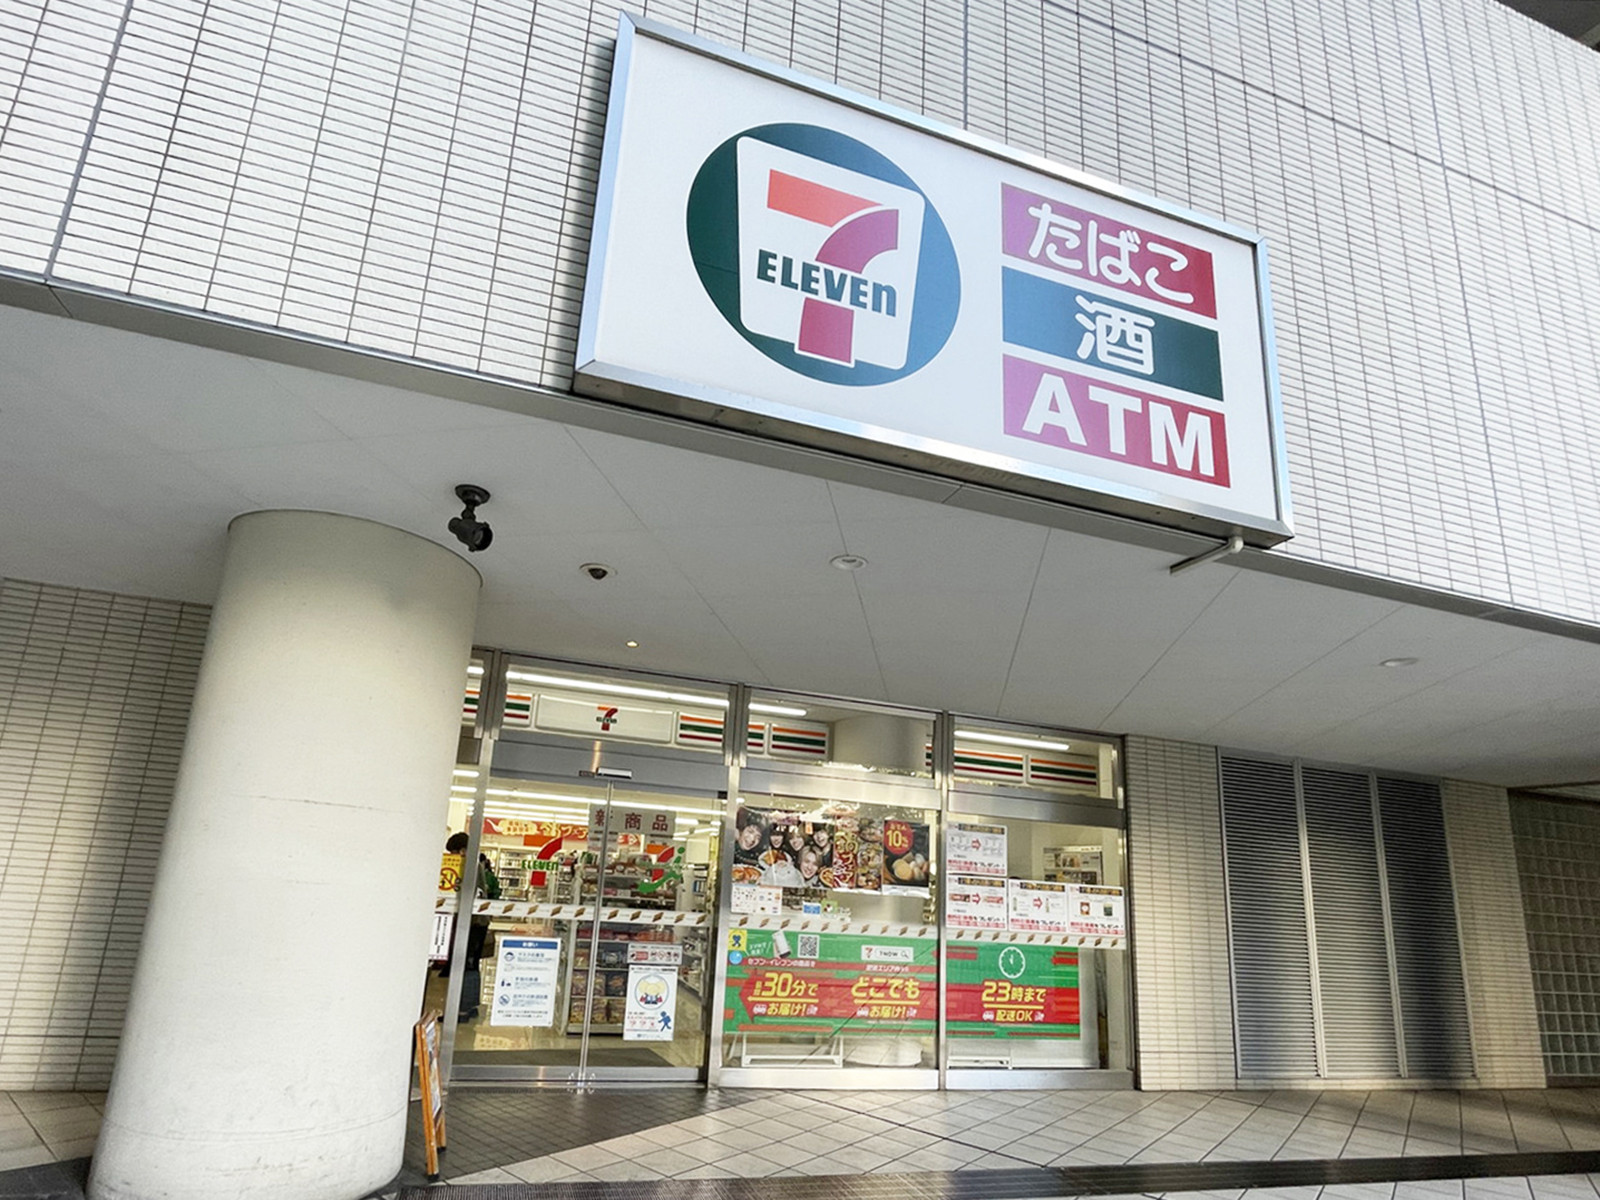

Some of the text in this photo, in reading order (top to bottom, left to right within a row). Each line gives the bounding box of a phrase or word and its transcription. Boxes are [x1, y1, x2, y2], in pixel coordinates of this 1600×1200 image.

[766, 168, 900, 366] 7
[1027, 202, 1195, 305] たばこ
[1075, 295, 1155, 377] 酒
[1022, 374, 1216, 478] ATM
[851, 976, 920, 999] どこでも
[981, 981, 1047, 1003] 23時まで
[996, 1009, 1033, 1022] 配送OK
